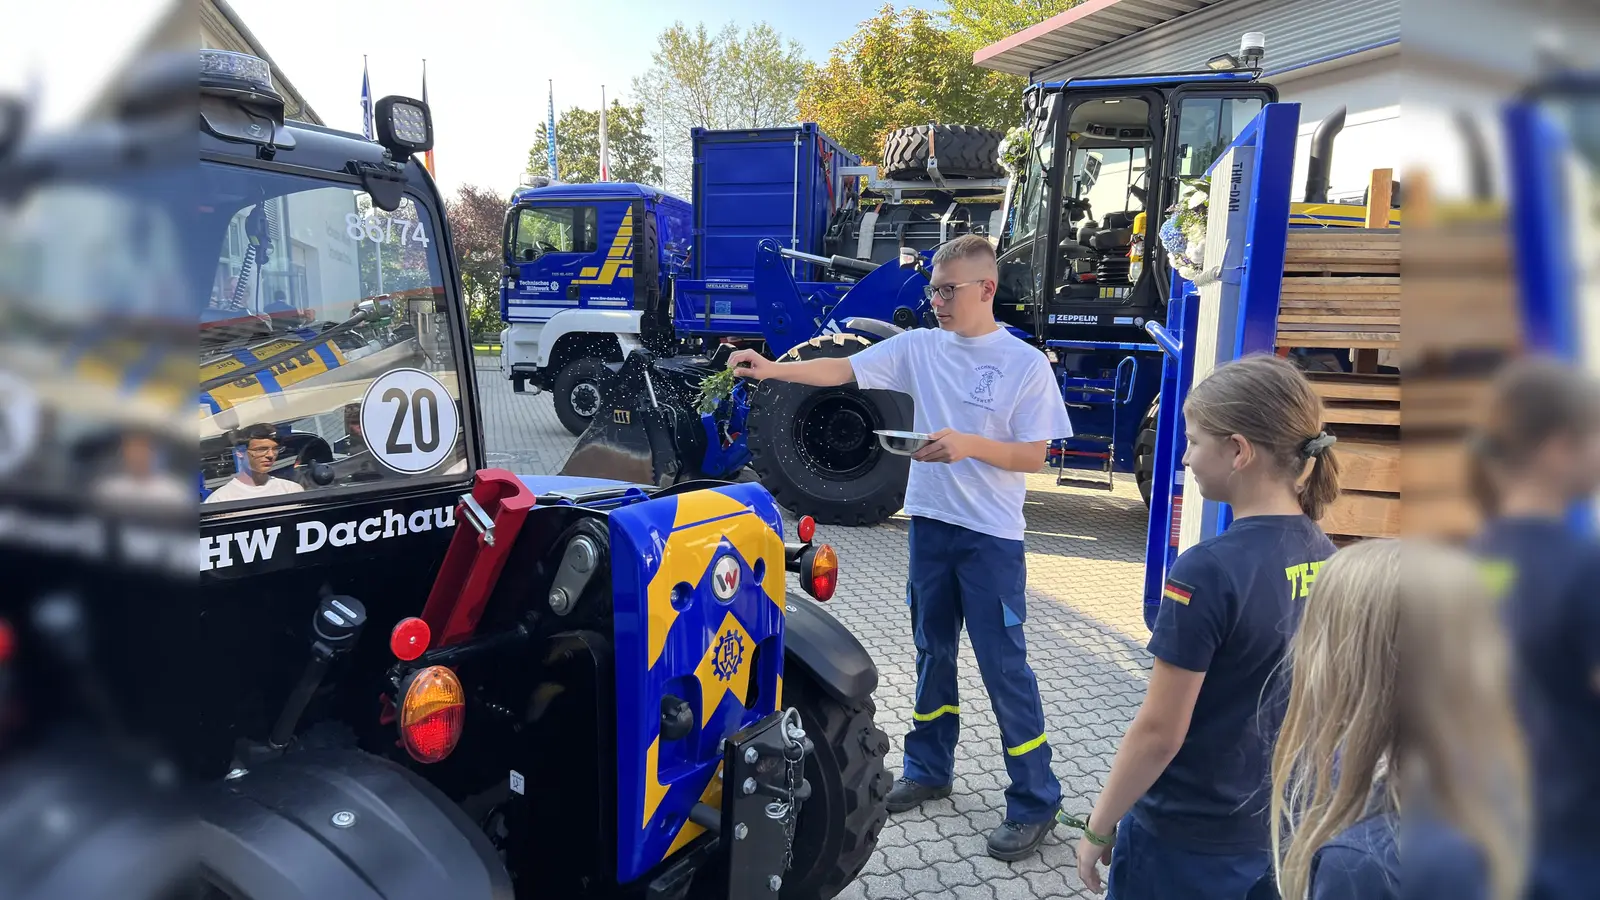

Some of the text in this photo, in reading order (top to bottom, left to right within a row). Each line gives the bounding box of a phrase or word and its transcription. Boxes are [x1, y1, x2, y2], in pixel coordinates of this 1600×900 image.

[344, 211, 430, 248] 86/74
[1056, 314, 1098, 322] ZEPPELIN
[974, 364, 1004, 379] TECHNISCHES
[381, 386, 439, 455] 20
[295, 505, 456, 555] Dachau
[1285, 560, 1327, 601] TH
